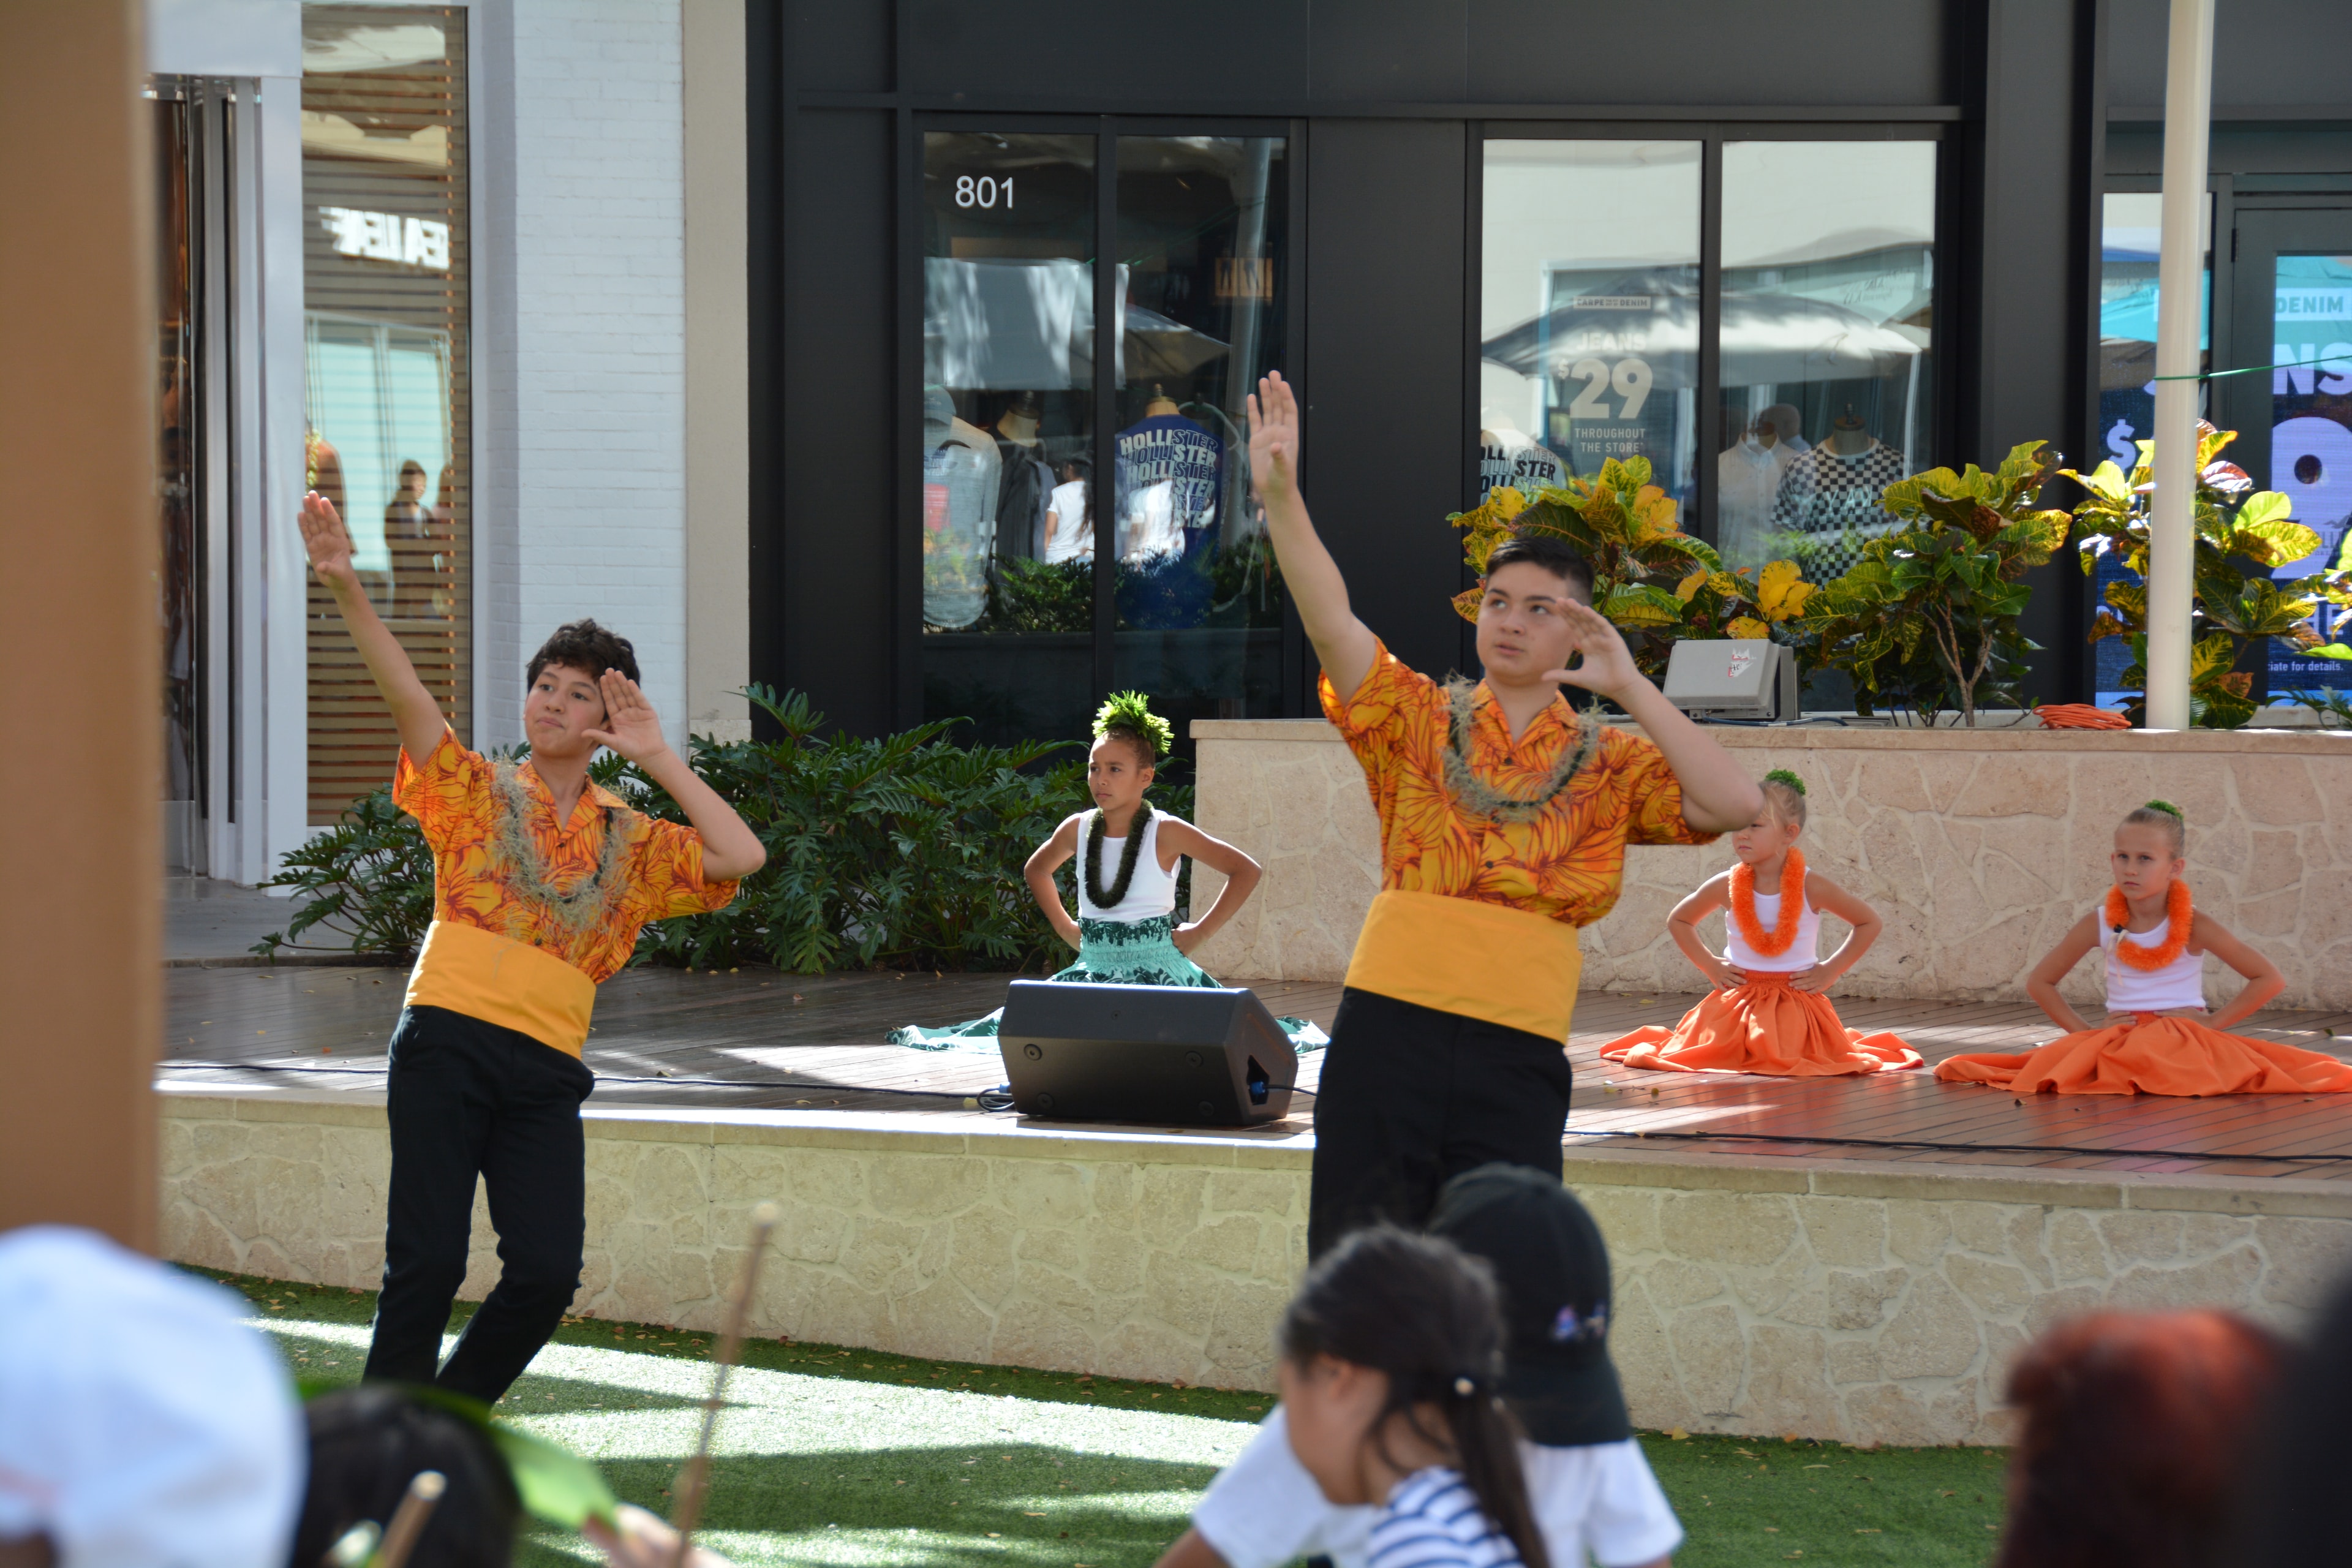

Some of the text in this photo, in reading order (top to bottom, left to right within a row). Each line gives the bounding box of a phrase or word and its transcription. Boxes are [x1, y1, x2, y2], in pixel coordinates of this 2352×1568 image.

[956, 176, 1012, 208] 801
[2275, 296, 2344, 314] DENIM
[1576, 333, 1647, 351] JEANS
[1558, 357, 1653, 418] $29
[1120, 429, 1218, 456] HOLLISTER
[1575, 428, 1646, 439] THROUGHOUT
[1580, 442, 1601, 453] THE
[2291, 662, 2305, 671] for
[2308, 661, 2343, 671] details.
